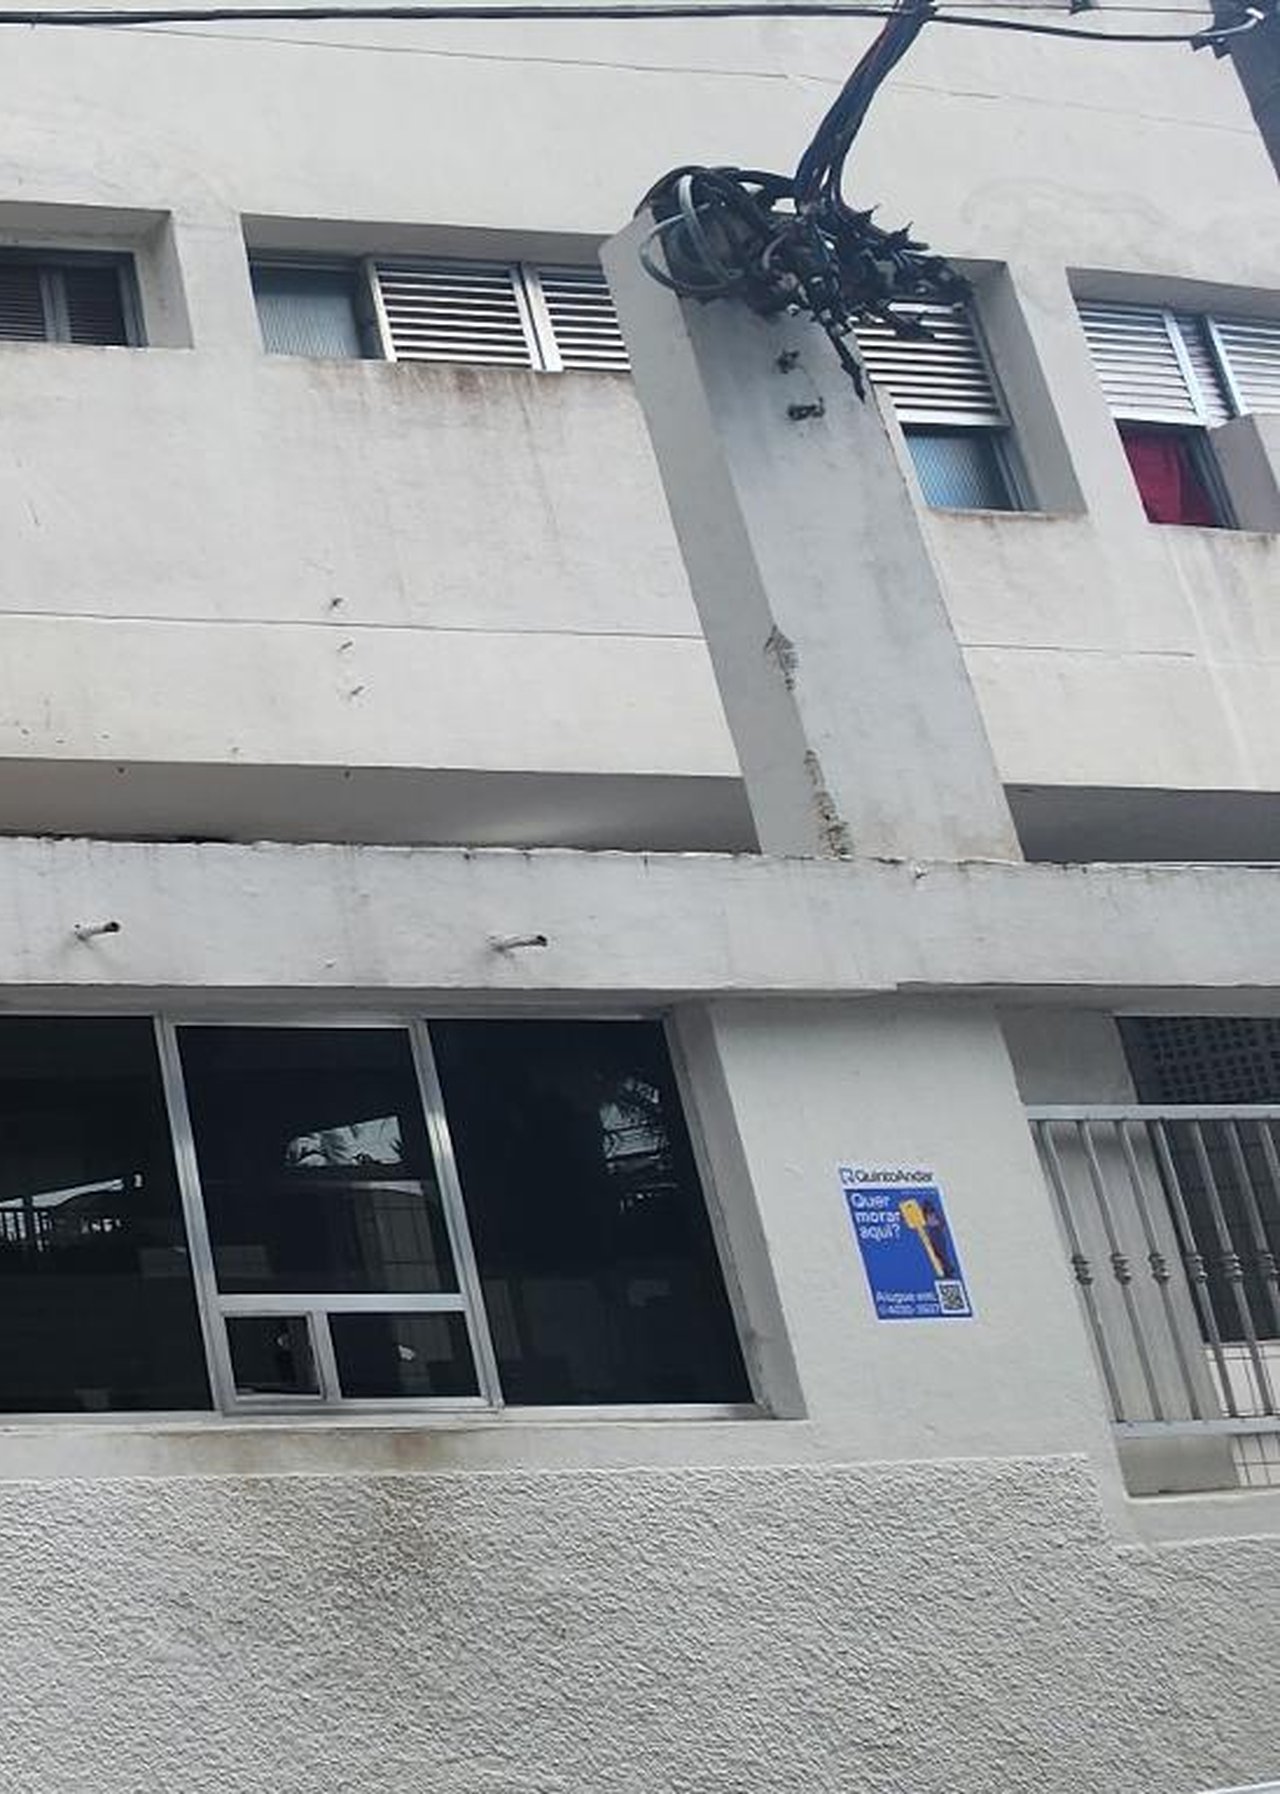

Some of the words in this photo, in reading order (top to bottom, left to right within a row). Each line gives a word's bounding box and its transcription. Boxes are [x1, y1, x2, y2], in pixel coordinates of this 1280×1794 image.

[855, 1168, 933, 1183] QuintoAndar
[851, 1193, 890, 1208] Quer
[855, 1211, 900, 1223] morar
[860, 1223, 901, 1241] aqui?
